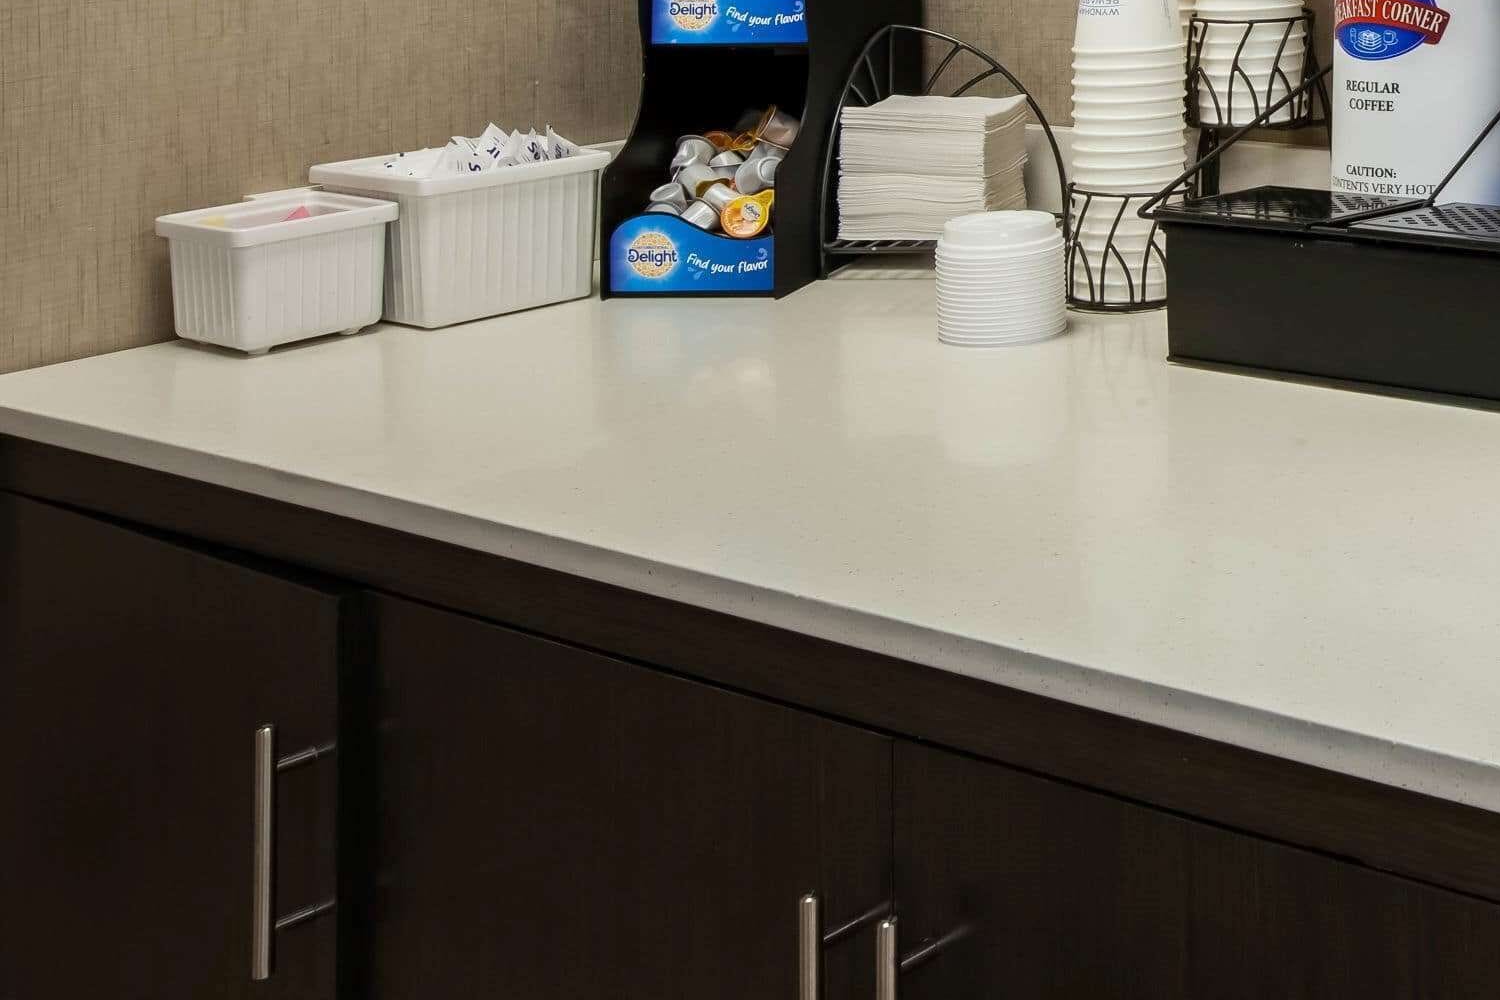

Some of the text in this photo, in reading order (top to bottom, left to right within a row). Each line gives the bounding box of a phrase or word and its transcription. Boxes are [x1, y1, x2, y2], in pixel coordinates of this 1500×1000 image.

[670, 3, 717, 19] Delight
[726, 7, 804, 26] Find your flavor
[1079, 8, 1120, 16] WYNDHA
[1382, 0, 1443, 33] CORNER
[1346, 79, 1400, 94] REGULAR
[1349, 98, 1394, 112] COFFEE
[1346, 164, 1397, 179] CAUTION:
[1371, 182, 1402, 194] VERY
[1405, 184, 1436, 195] HOT
[628, 249, 677, 266] Delight
[686, 253, 768, 274] Find your flavor
